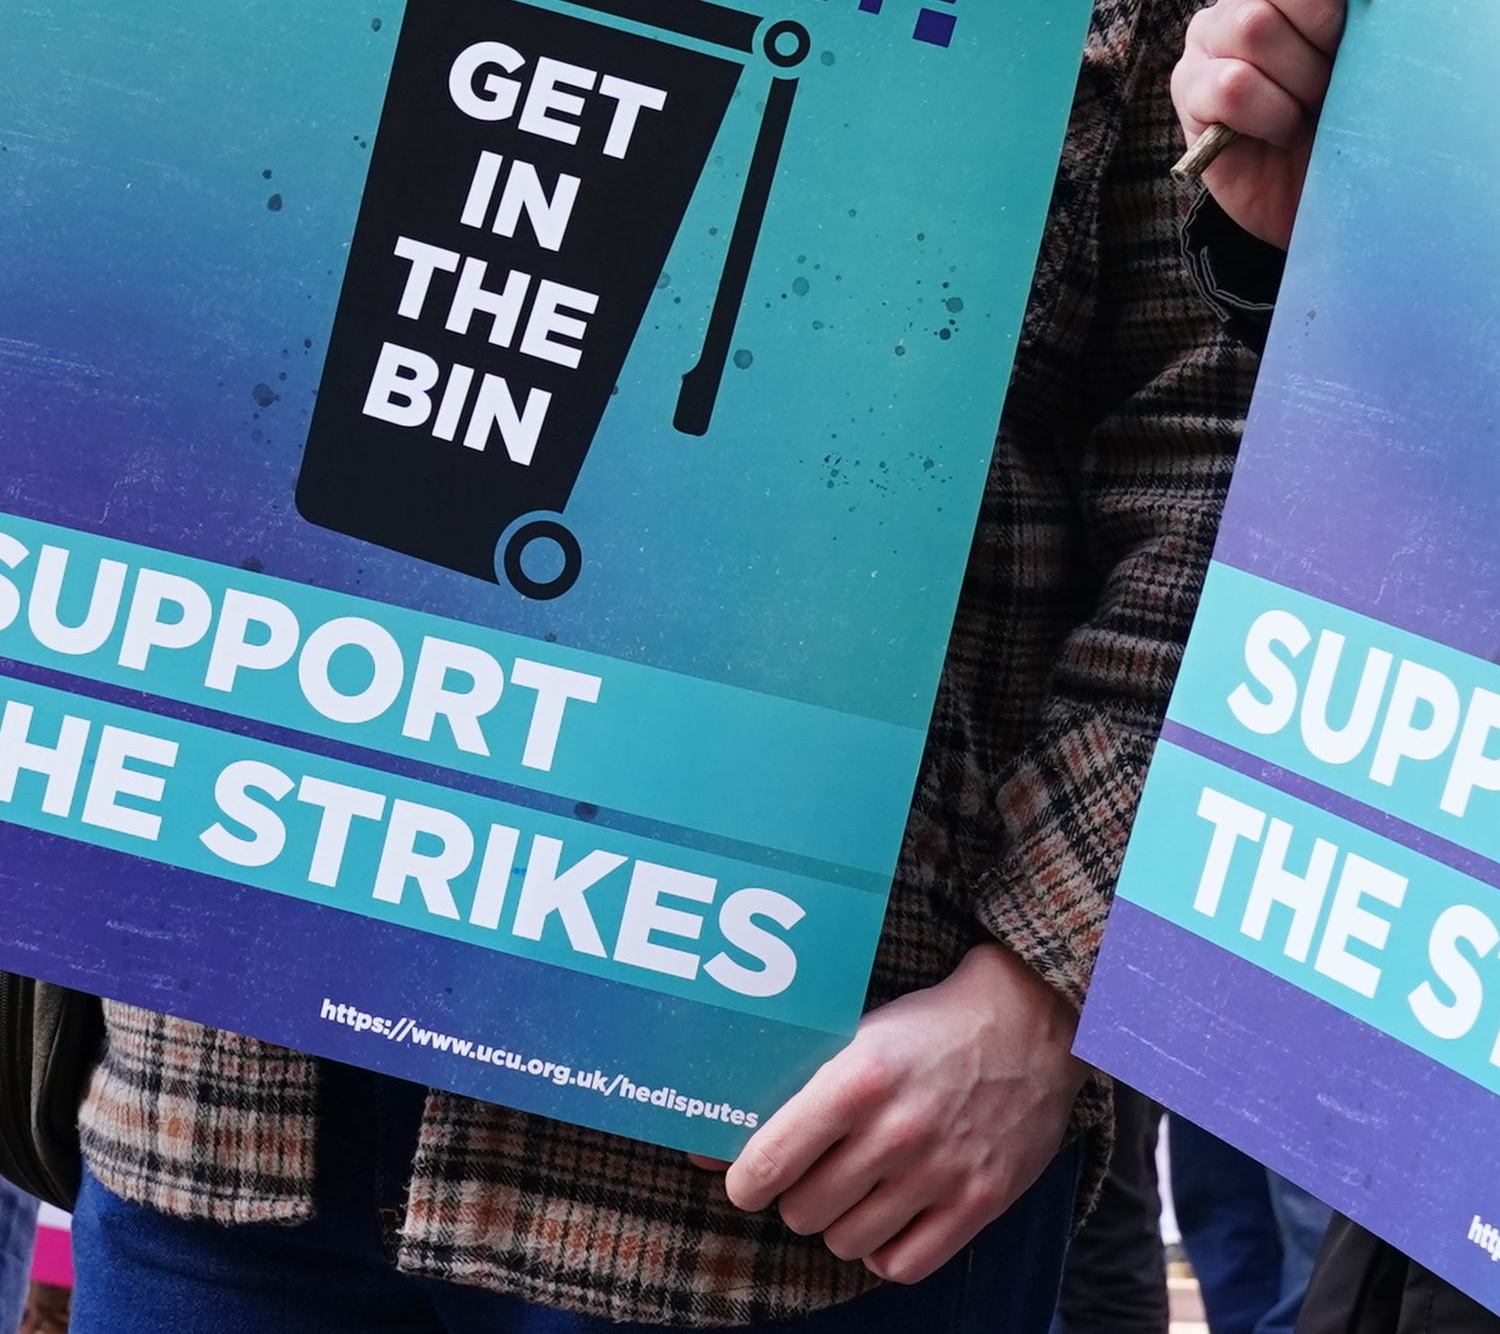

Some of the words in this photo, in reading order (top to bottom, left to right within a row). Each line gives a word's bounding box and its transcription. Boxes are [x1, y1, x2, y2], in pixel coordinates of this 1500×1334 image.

[447, 40, 669, 160] GET
[460, 149, 582, 253] IN
[393, 235, 600, 370] THE
[362, 341, 553, 467] BIN
[199, 759, 807, 999] STRIKES
[1193, 787, 1410, 1000] THE
[319, 997, 761, 1131] https://www.ucu.org.uk/hedisputes
